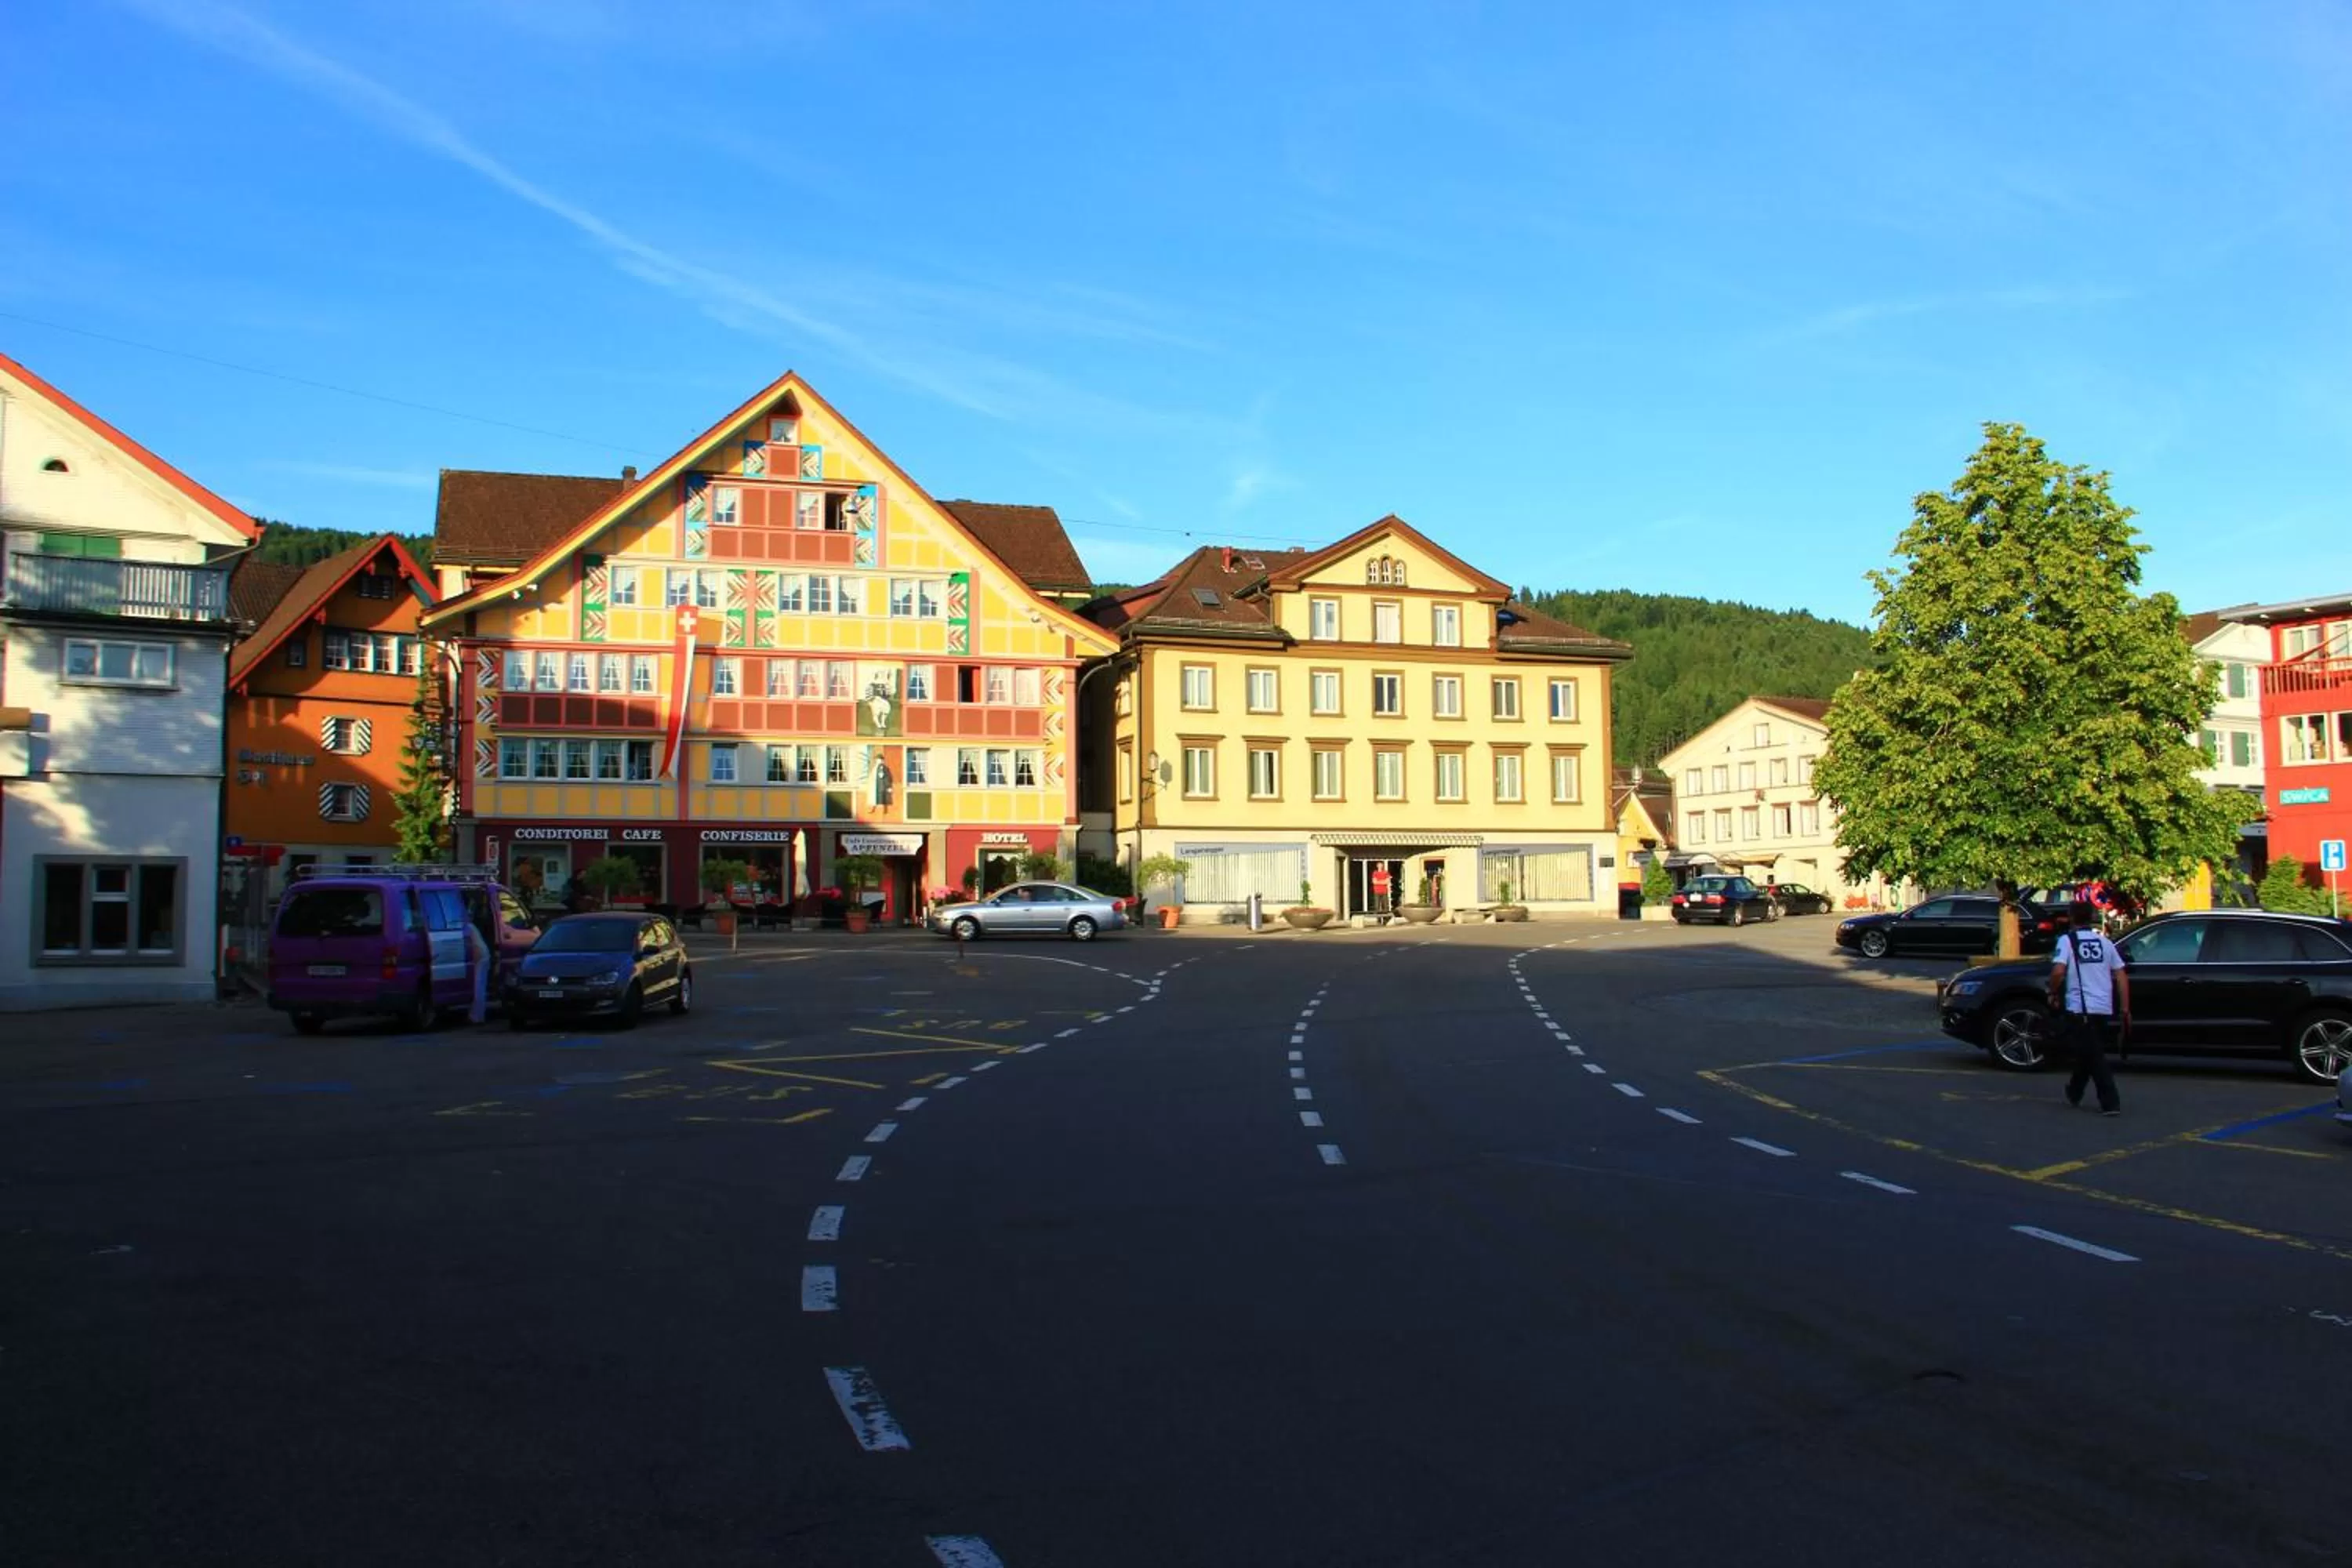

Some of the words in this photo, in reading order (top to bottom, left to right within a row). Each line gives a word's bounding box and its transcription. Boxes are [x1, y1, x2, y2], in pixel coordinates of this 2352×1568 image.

[514, 828, 609, 840] CONDITOREI
[622, 829, 662, 840] CAFE
[700, 829, 790, 841] CONFISERIE
[982, 833, 1028, 843] HOTEL
[2078, 942, 2102, 960] 63
